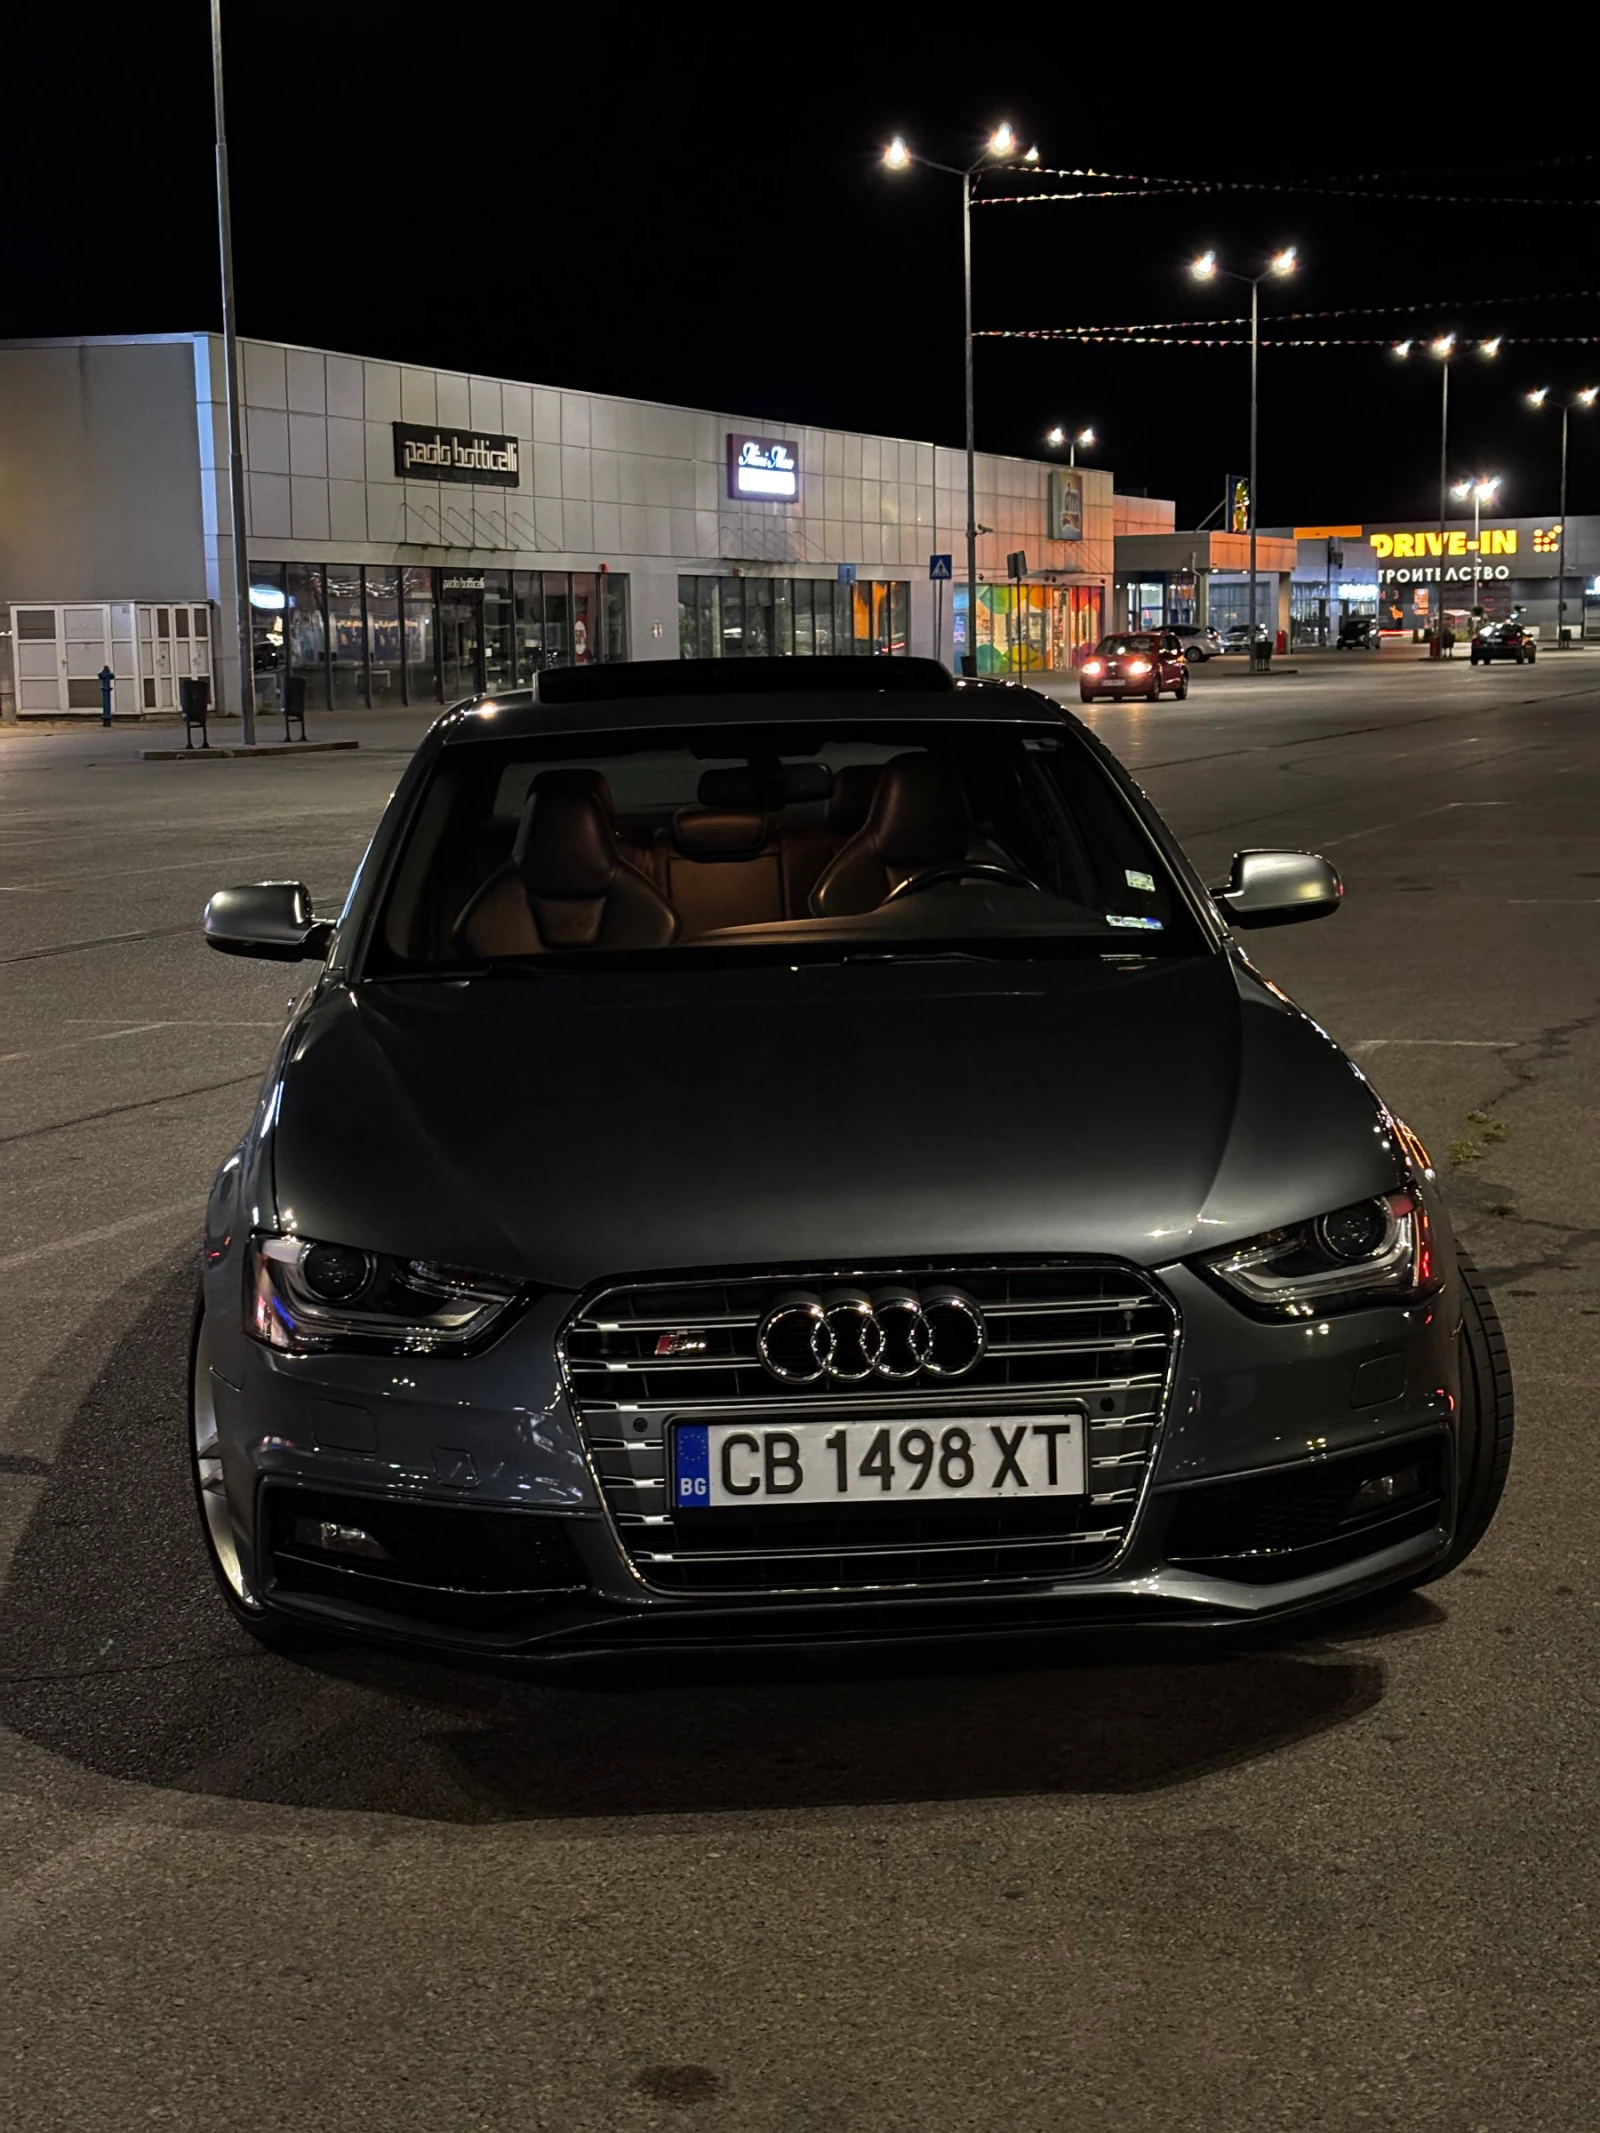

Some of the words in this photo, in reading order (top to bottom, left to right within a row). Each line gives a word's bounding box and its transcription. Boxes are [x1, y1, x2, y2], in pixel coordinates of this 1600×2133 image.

[403, 435, 451, 469] paolo
[452, 436, 517, 473] botticelli
[1370, 529, 1518, 558] DRIVE-IN
[1378, 565, 1510, 584] ТРОИТЕЛСТВО
[721, 1431, 803, 1495] CB
[825, 1426, 975, 1493] 1498
[990, 1424, 1071, 1488] XT
[680, 1477, 707, 1497] BG
